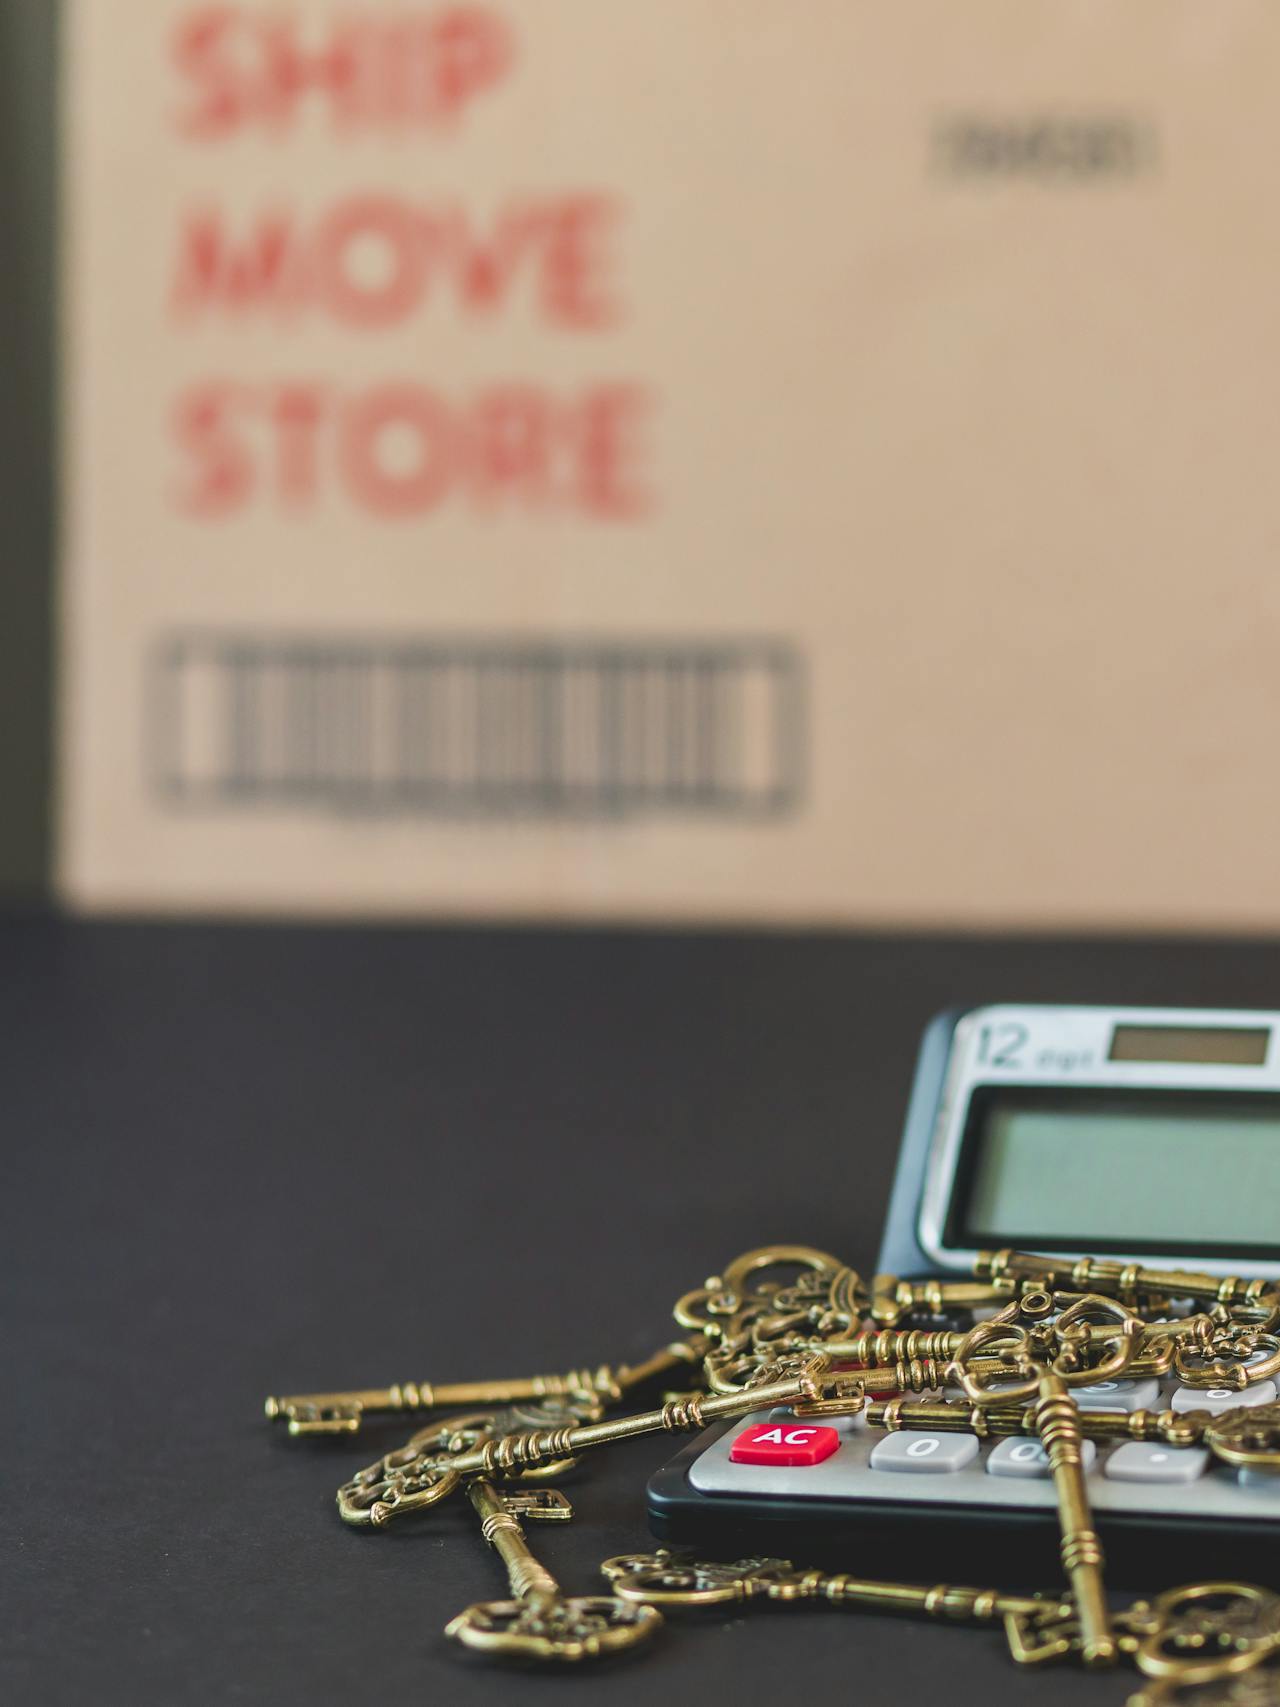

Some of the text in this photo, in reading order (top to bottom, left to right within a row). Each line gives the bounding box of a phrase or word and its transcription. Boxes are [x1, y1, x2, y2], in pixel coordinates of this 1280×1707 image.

[170, 7, 514, 140] SHIP
[171, 194, 626, 329] MOVE
[170, 381, 656, 521] STORE
[975, 1022, 1029, 1068] 12
[751, 1428, 818, 1446] AC
[906, 1438, 941, 1457] 0
[1009, 1442, 1049, 1462] 0
